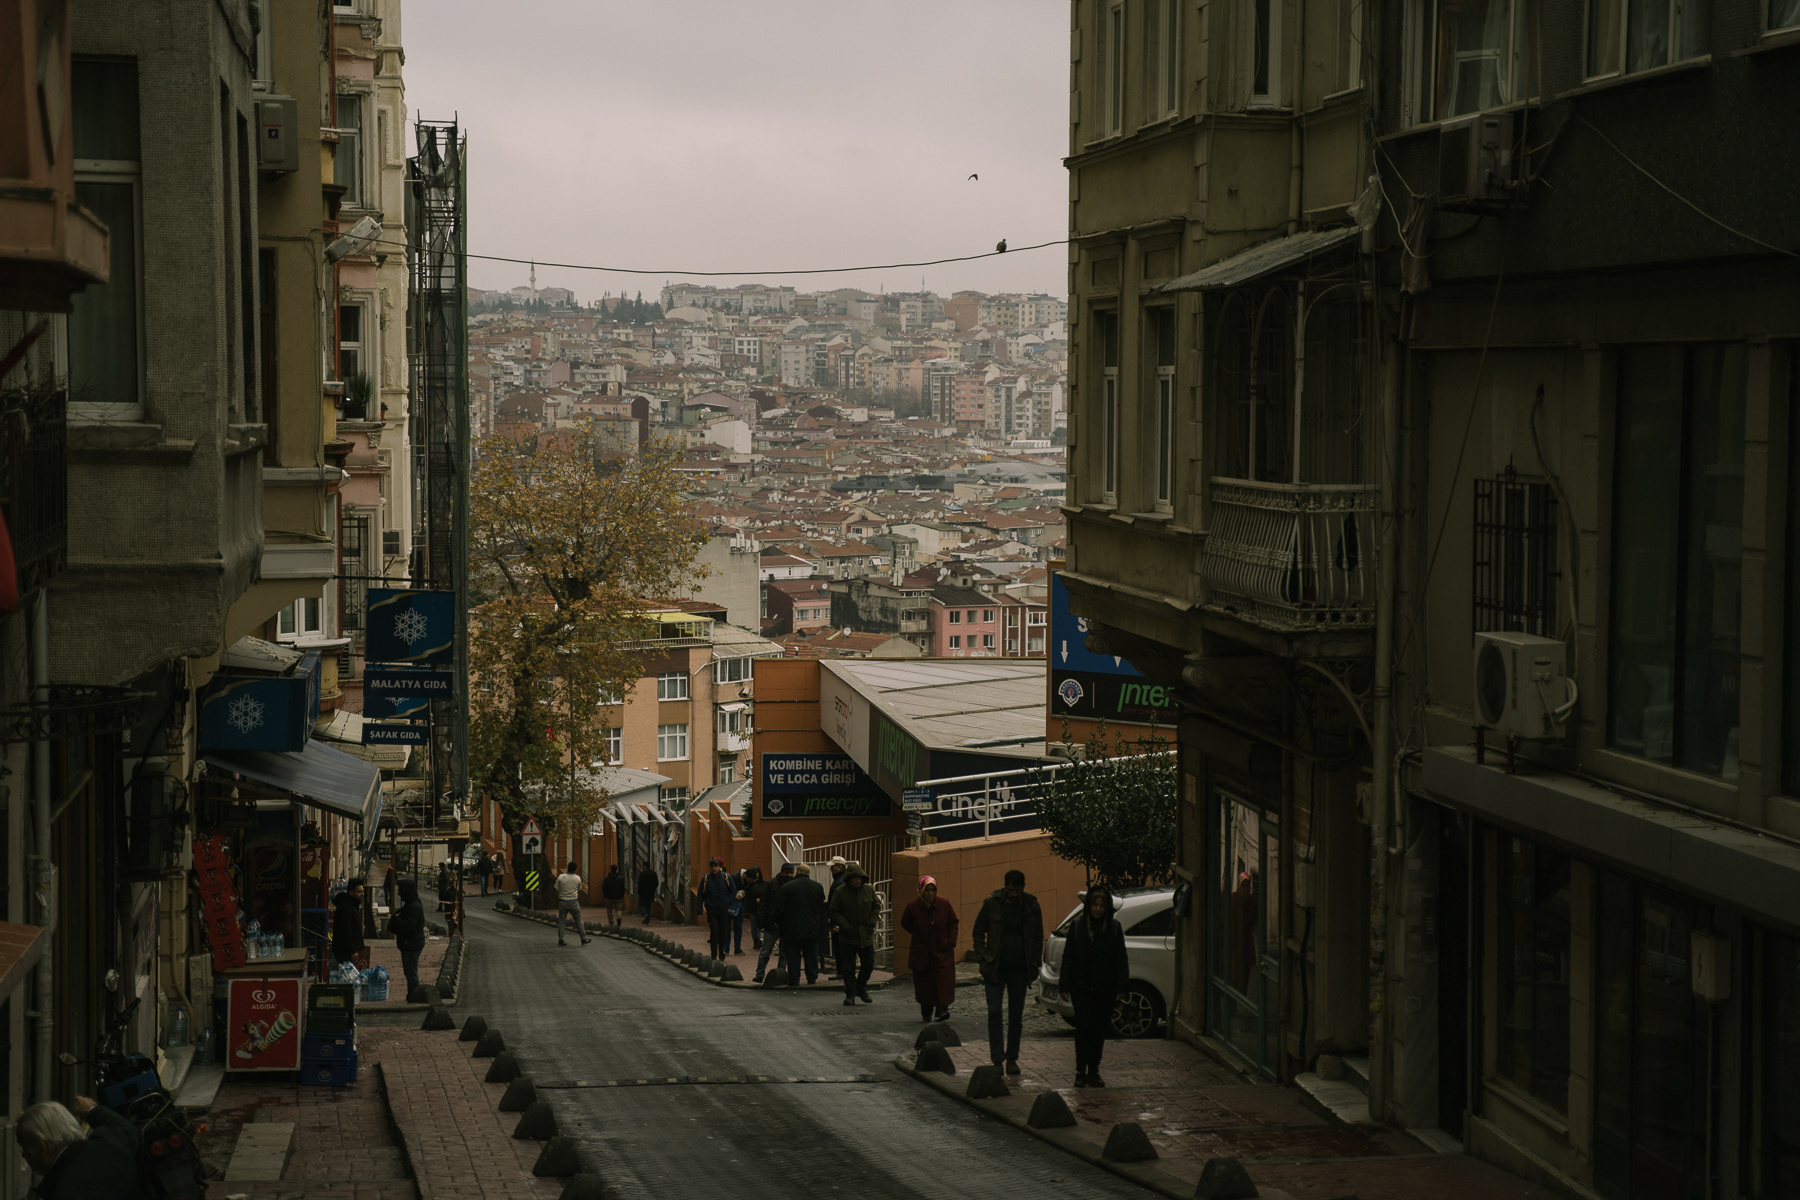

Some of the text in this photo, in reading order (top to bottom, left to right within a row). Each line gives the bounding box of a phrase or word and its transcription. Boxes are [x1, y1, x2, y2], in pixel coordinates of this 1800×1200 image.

[371, 680, 447, 689] MALATYA GIDA
[370, 730, 420, 739] ŞAFAK GIDA
[769, 758, 855, 770] KOMBİNE KART
[769, 771, 856, 786] VE LOCA GİRİŞİ
[256, 881, 285, 892] pepsi
